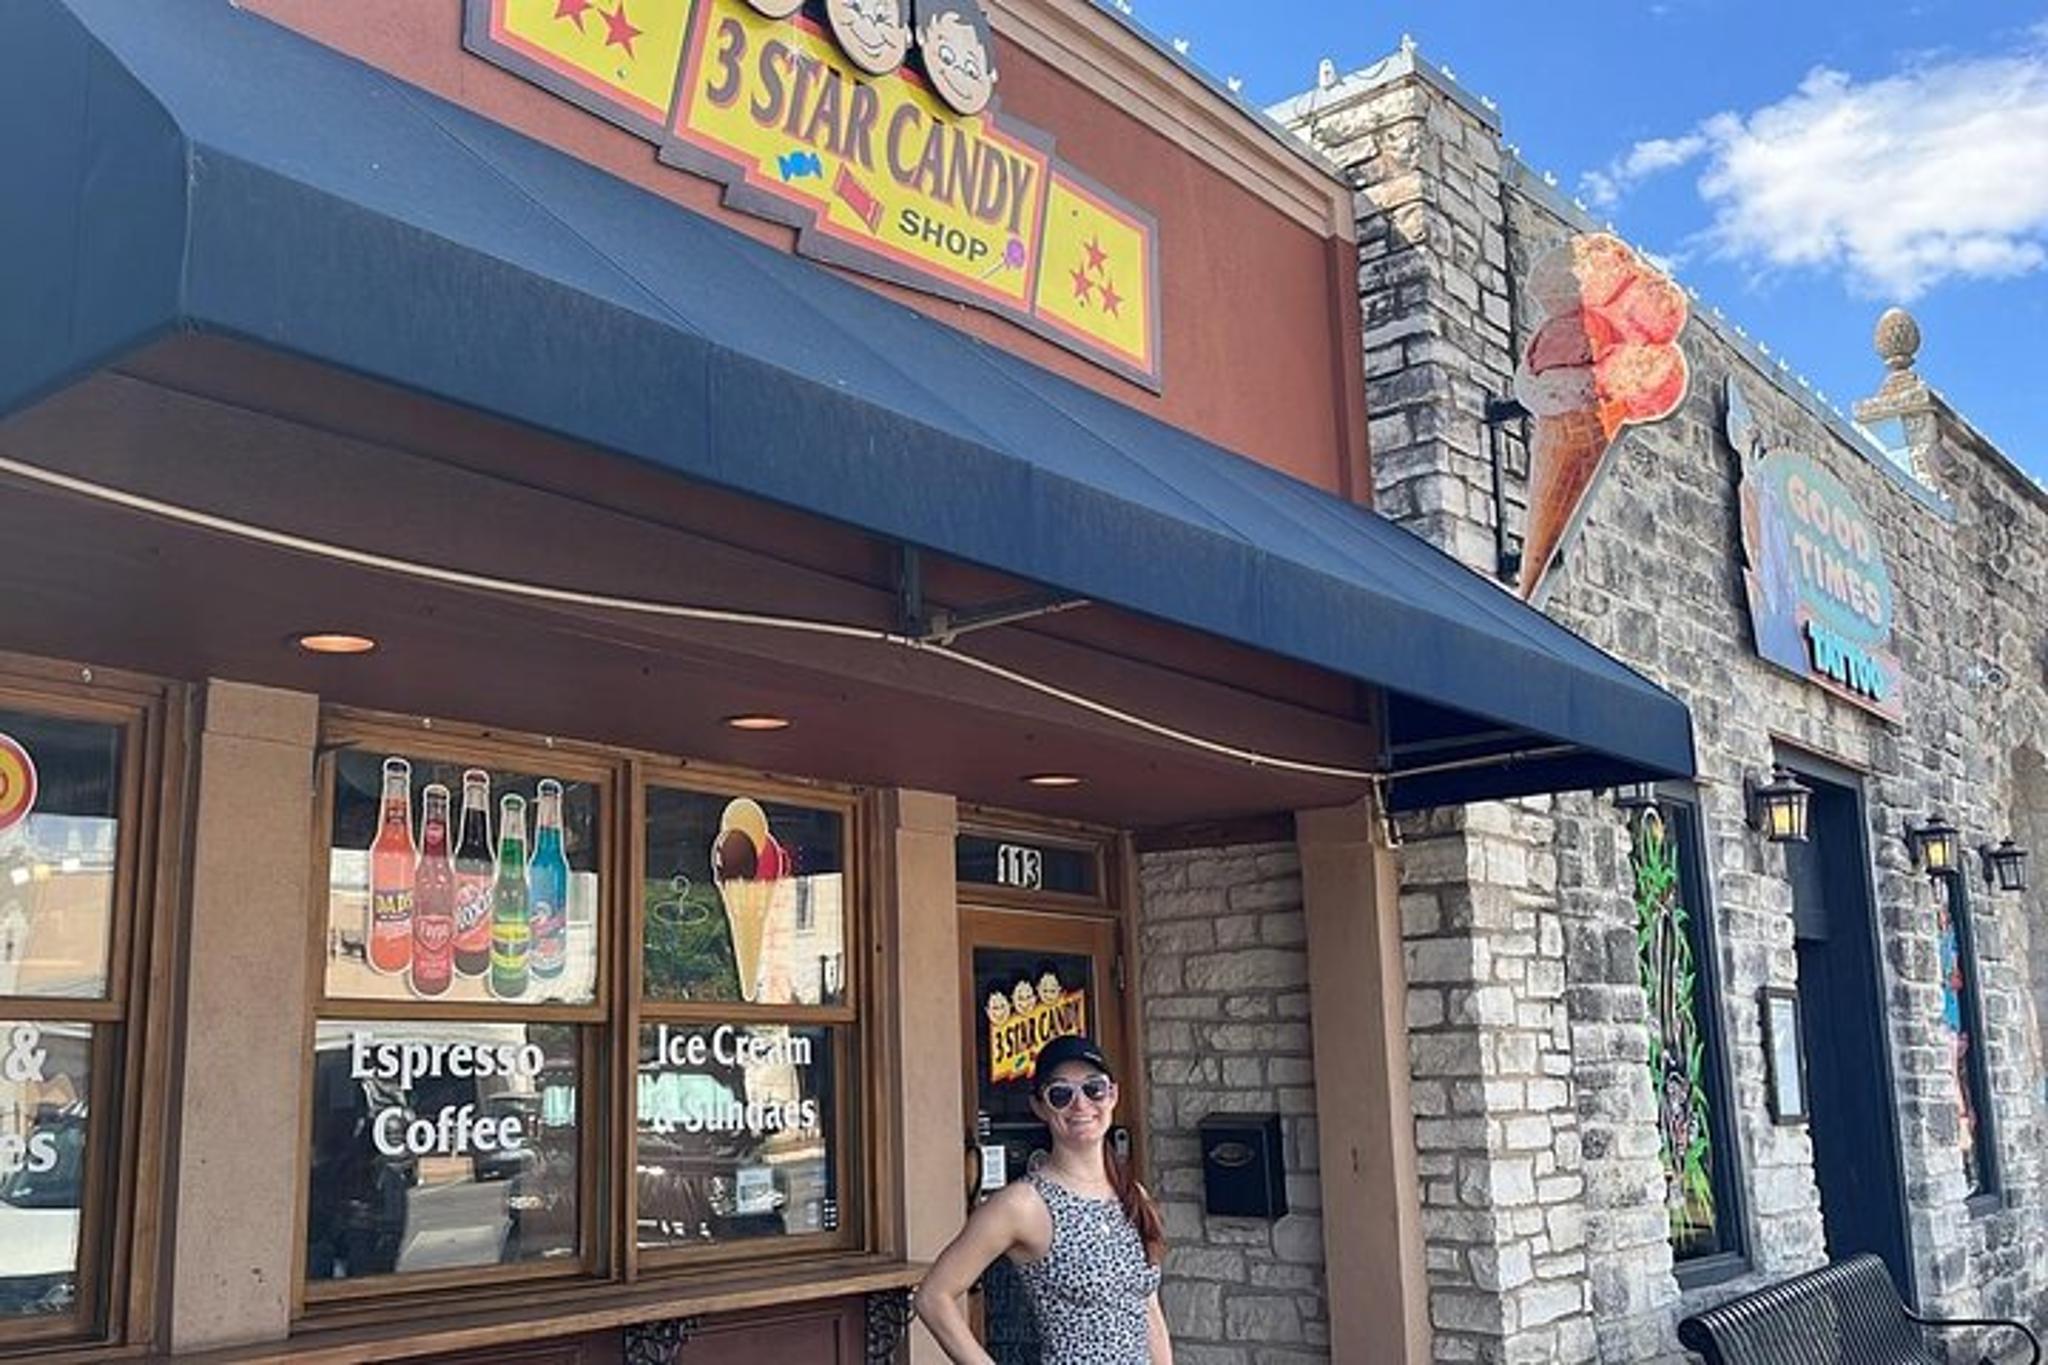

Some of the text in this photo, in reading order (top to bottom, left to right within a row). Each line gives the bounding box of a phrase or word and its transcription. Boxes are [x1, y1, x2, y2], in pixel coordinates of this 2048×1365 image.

[707, 17, 1032, 235] 3 STAR CANDY
[899, 208, 989, 263] SHOP
[1787, 473, 1870, 564] GOOD
[1792, 530, 1882, 628] TIMES
[998, 844, 1041, 889] 113
[5, 1027, 47, 1082] &
[351, 1030, 545, 1091] Espresso
[657, 1023, 812, 1066] Ice Cream
[371, 1104, 524, 1156] Coffee
[684, 1091, 817, 1134] Sundaes
